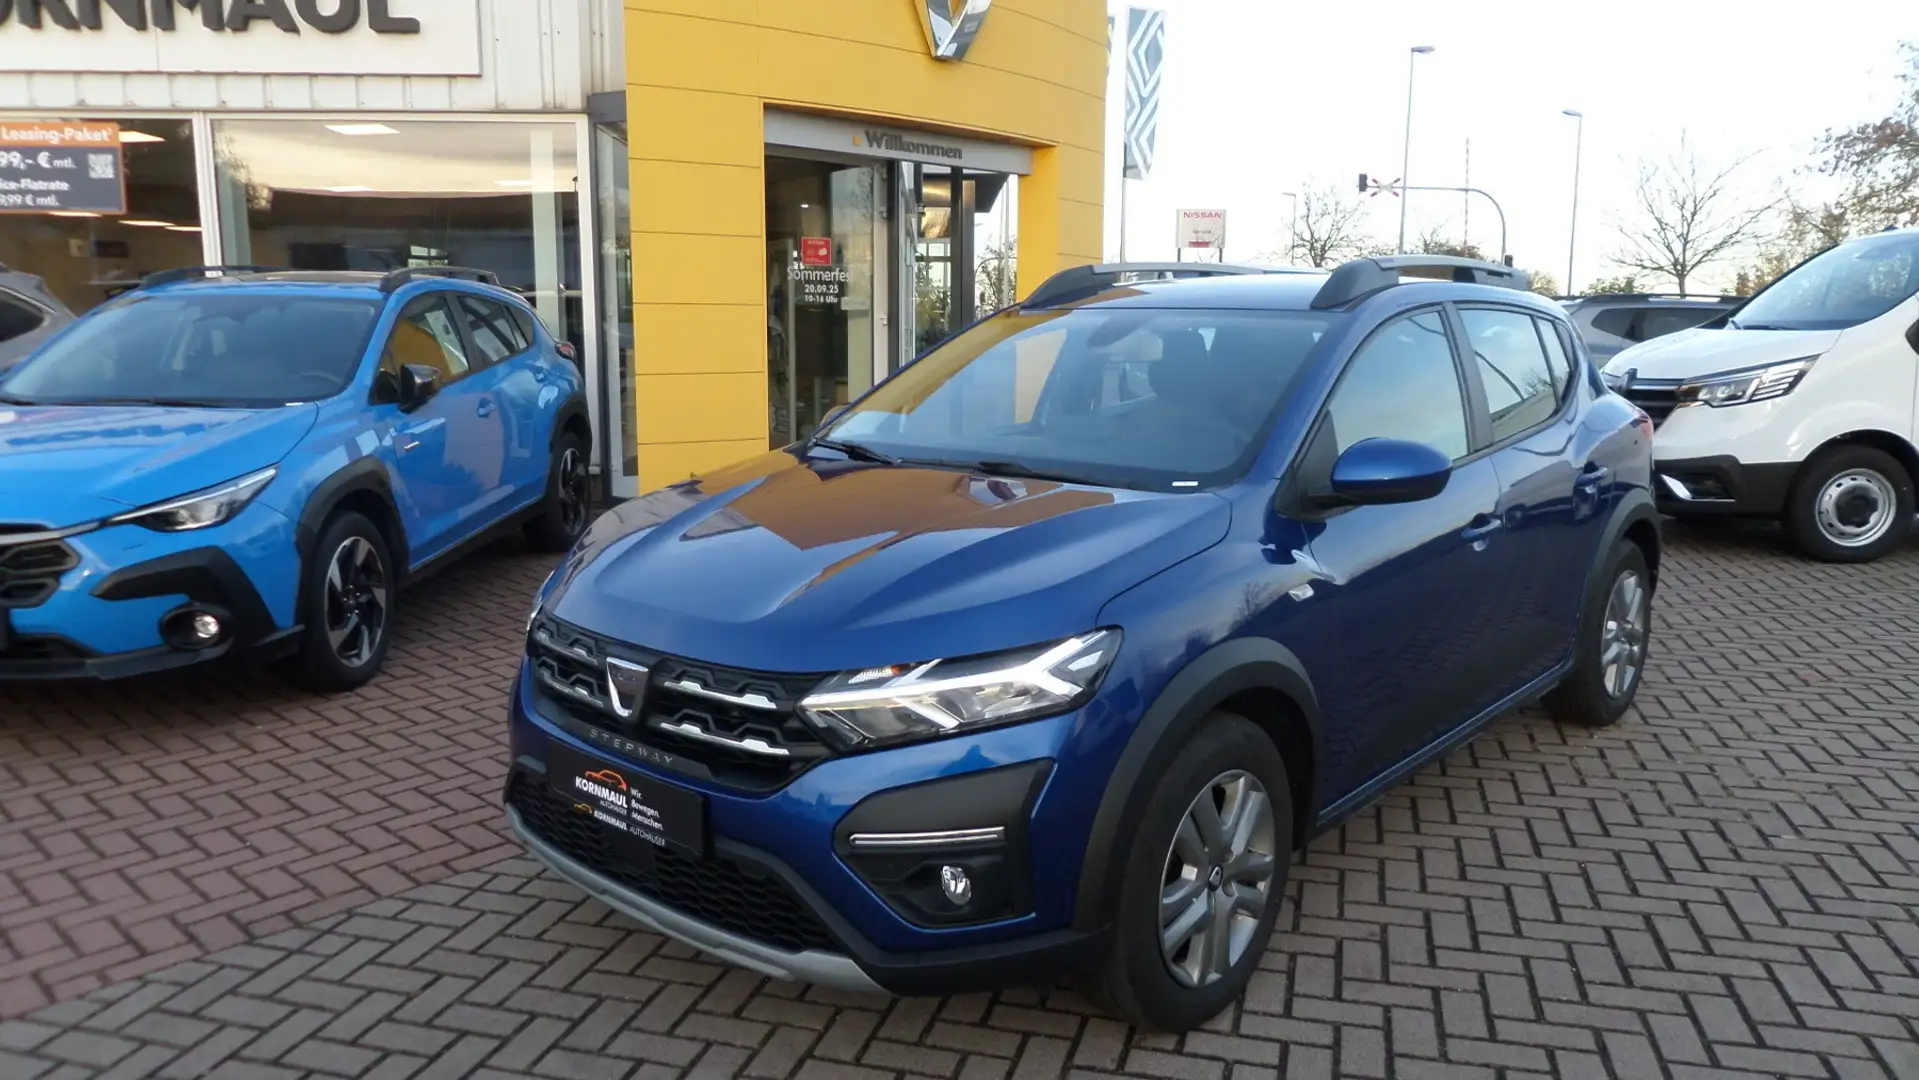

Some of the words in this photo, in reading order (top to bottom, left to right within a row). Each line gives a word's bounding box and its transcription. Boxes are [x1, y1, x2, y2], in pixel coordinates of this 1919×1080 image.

[864, 128, 963, 160] Willkommen
[37, 151, 52, 169] €
[1183, 211, 1222, 219] NISSAN
[787, 266, 850, 282] Sommerfes
[804, 284, 839, 294] 20.09.25
[825, 295, 839, 303] Uhr
[588, 728, 673, 764] STEPWAY
[575, 776, 628, 808] KORNMAUL
[593, 809, 628, 831] KORNMAUL
